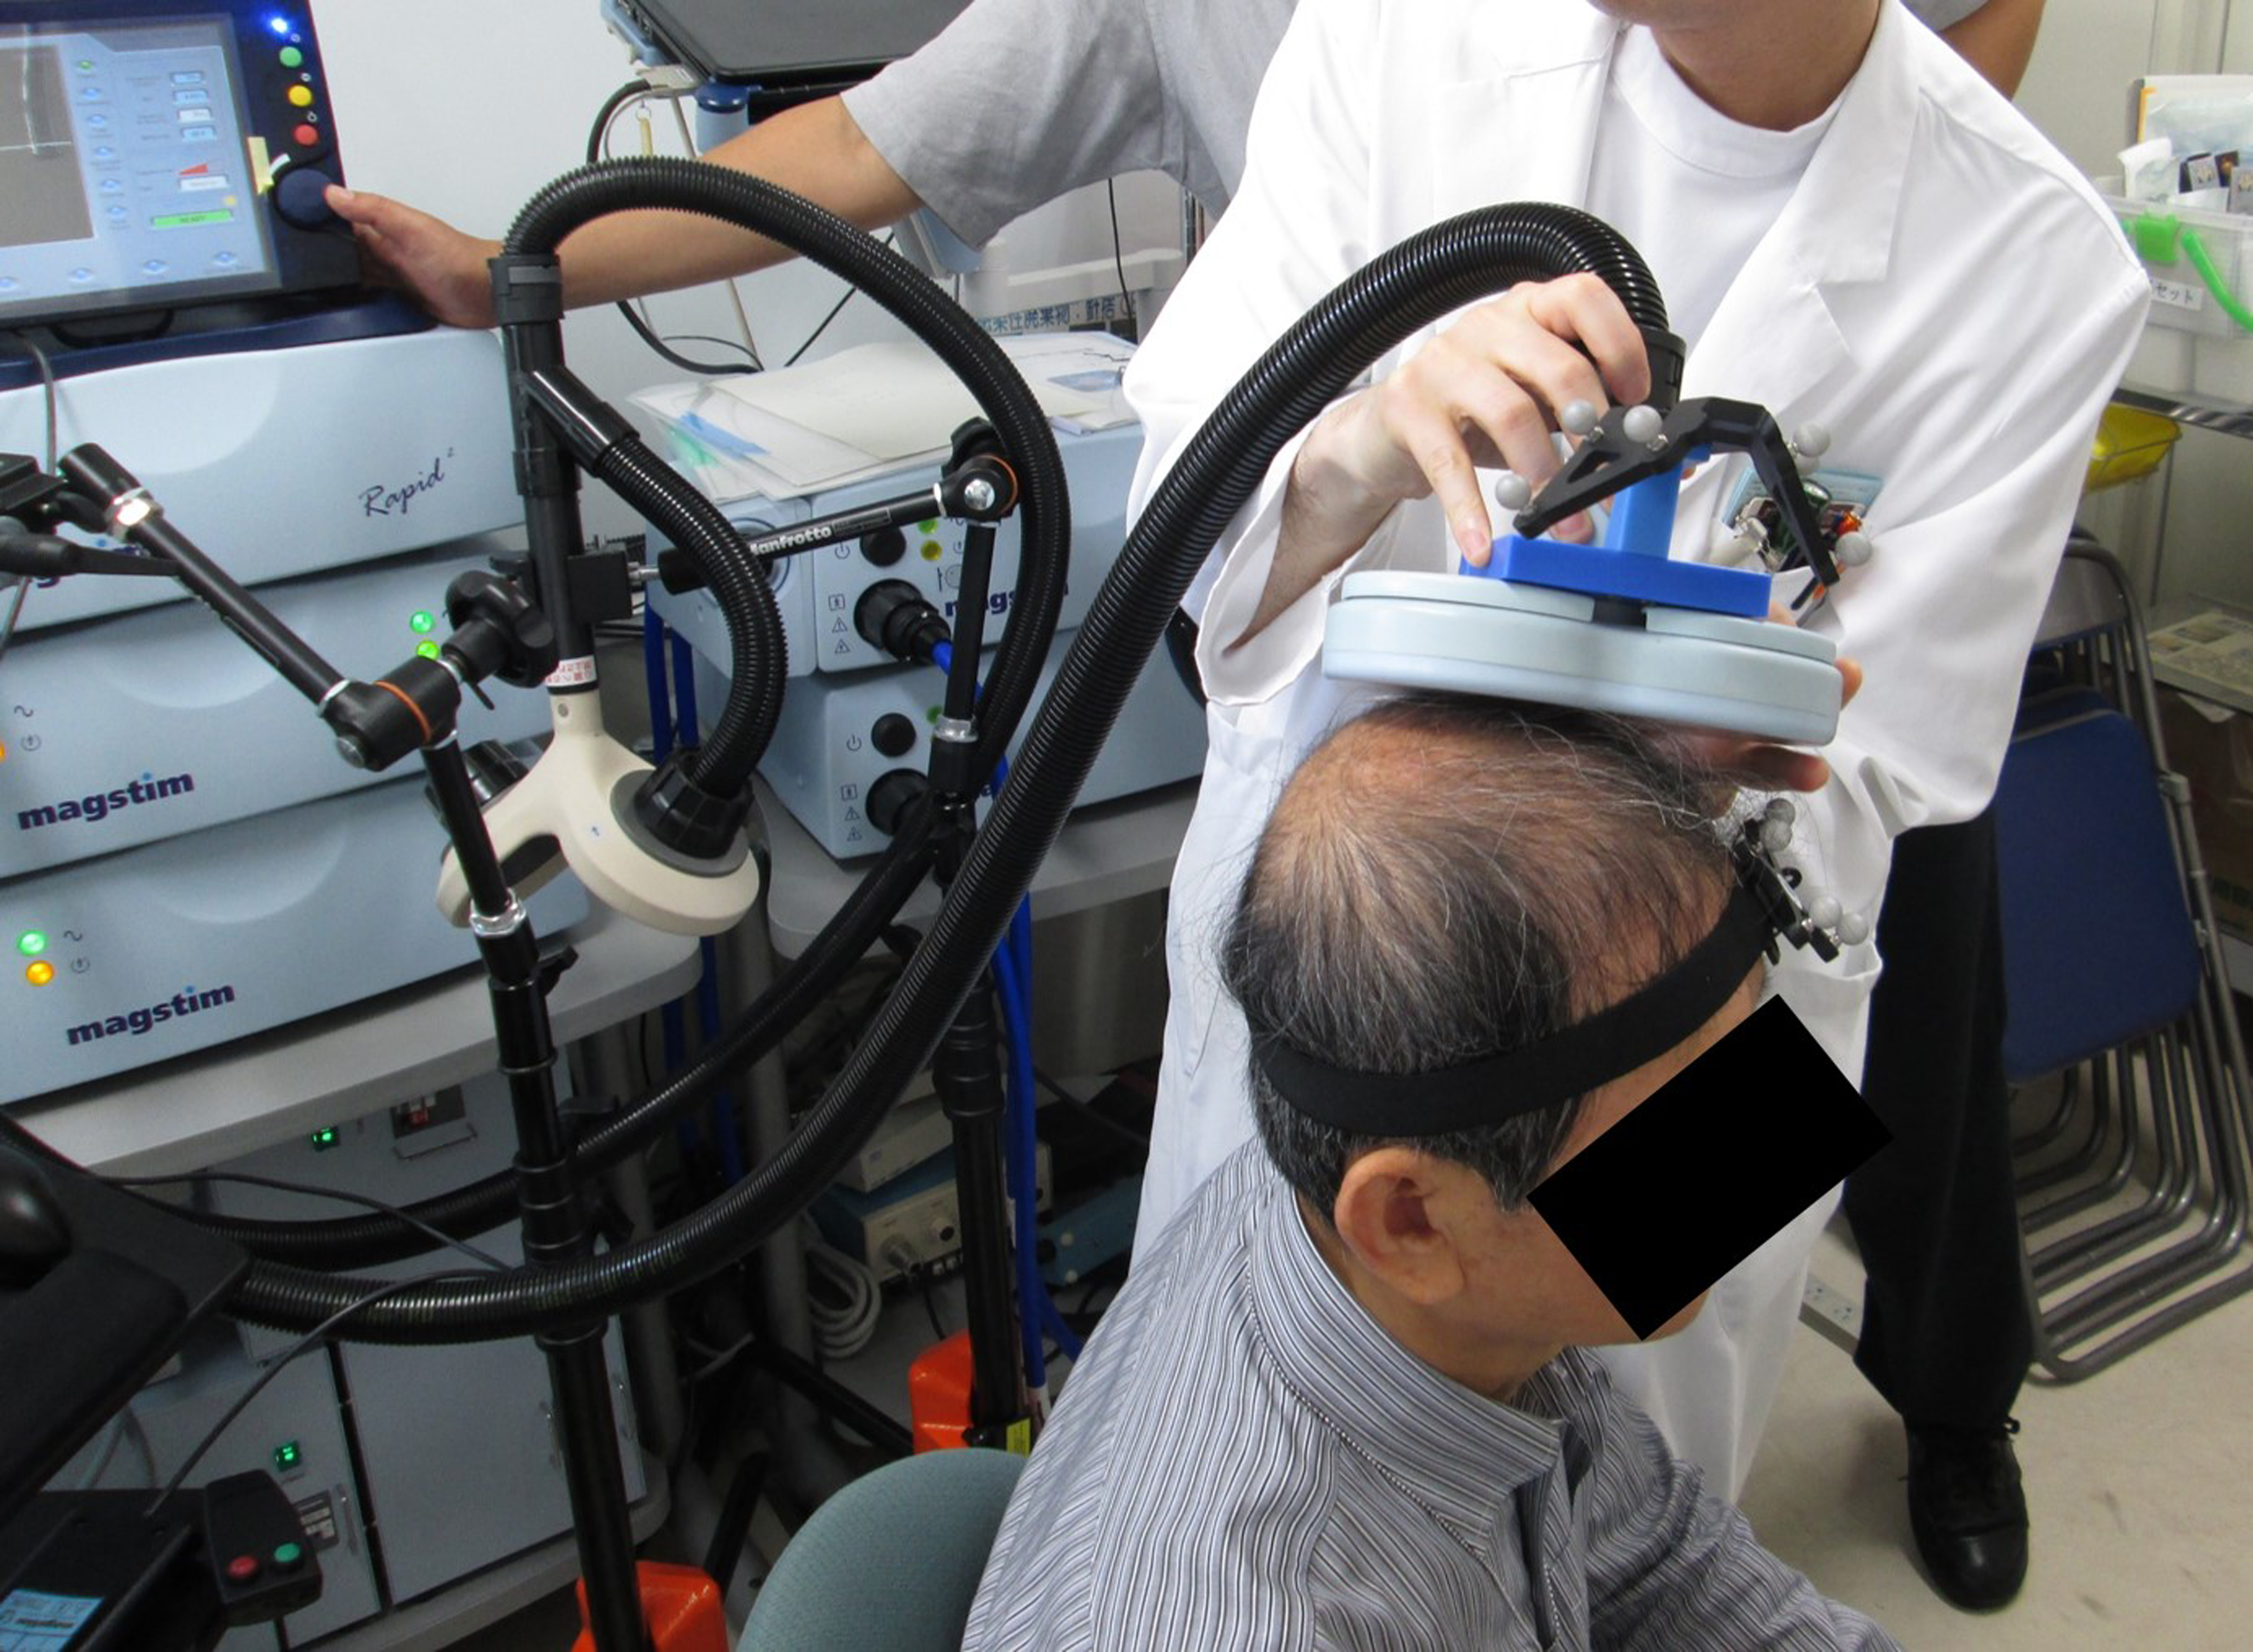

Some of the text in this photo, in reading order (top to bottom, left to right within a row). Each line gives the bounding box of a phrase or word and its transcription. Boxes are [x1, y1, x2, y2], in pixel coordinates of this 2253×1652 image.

[2150, 280, 2193, 305] セット
[18, 772, 194, 830] magstim
[66, 985, 235, 1045] magstim
